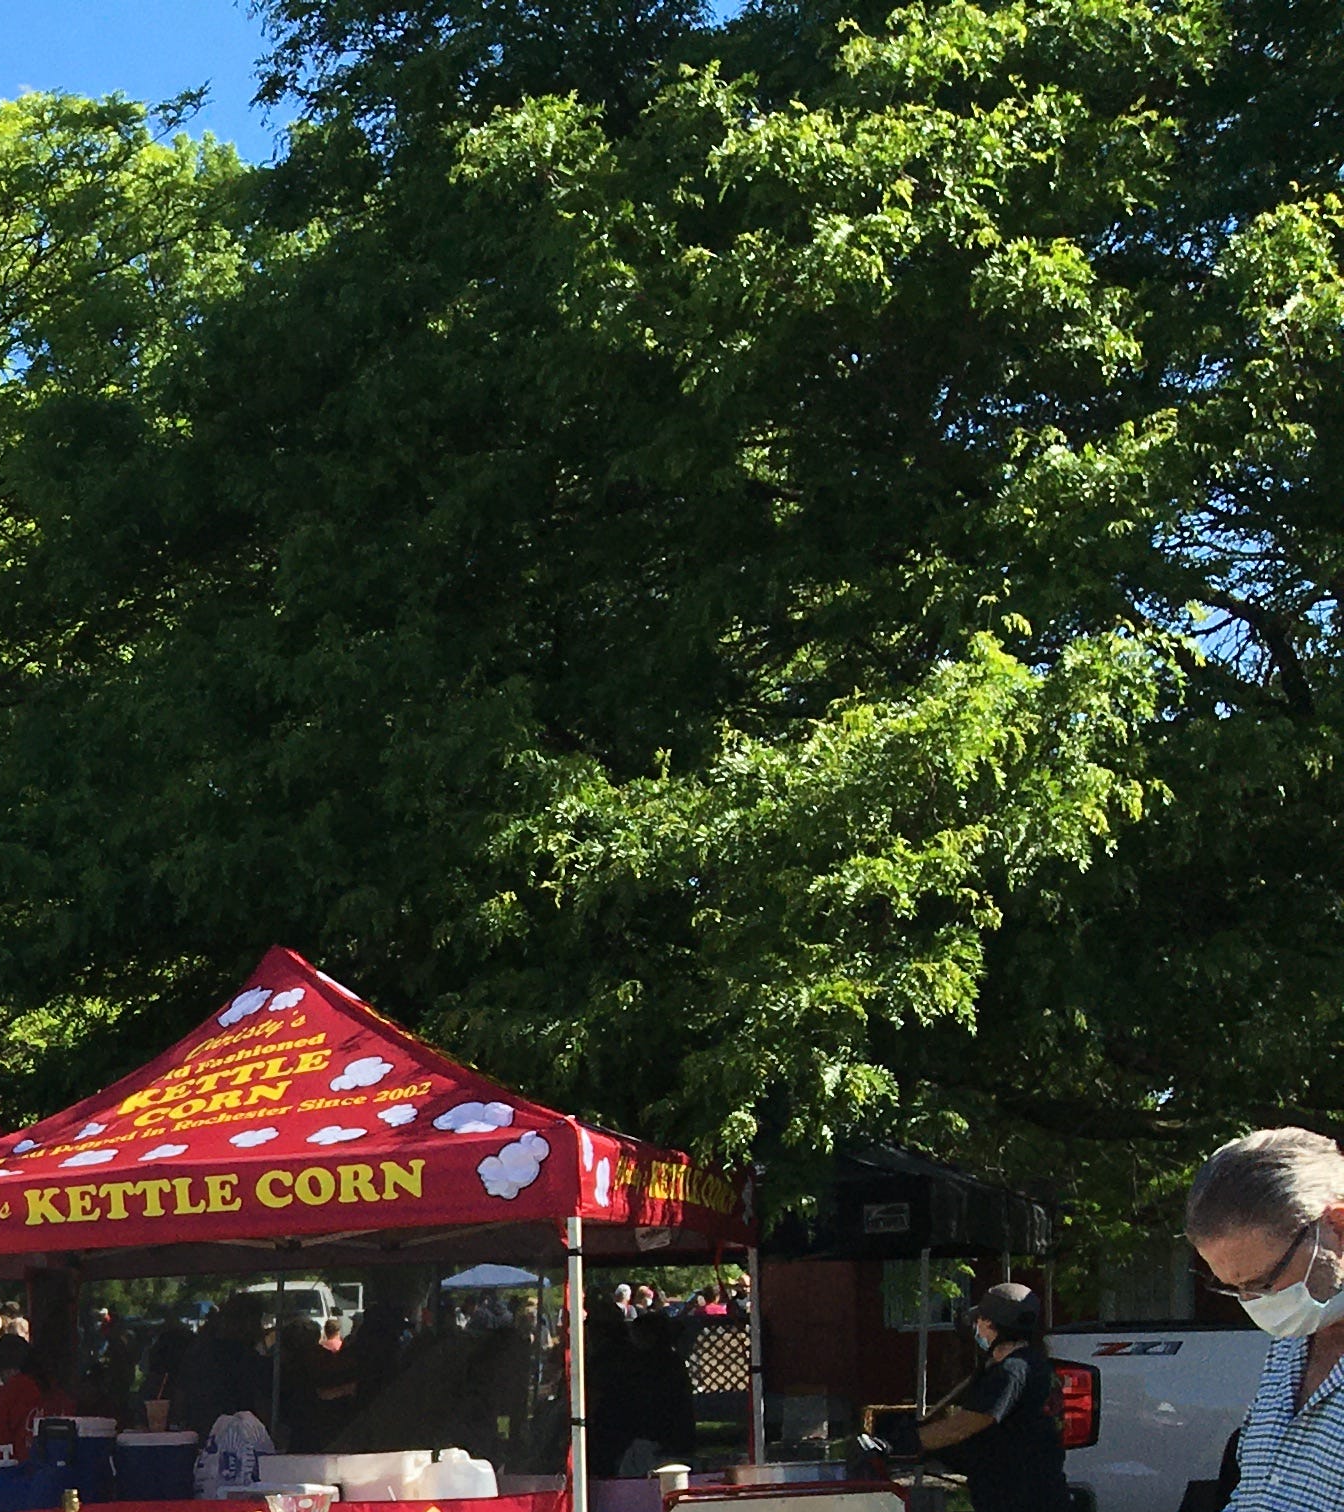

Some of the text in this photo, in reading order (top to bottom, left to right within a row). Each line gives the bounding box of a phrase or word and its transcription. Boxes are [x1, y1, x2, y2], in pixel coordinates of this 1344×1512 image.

[117, 1048, 333, 1116] KETTLE
[195, 1032, 327, 1073] Fashioned
[51, 1131, 138, 1157] Popped
[141, 1127, 166, 1139] in
[170, 1104, 293, 1132] Rochester
[296, 1093, 368, 1113] Since
[372, 1081, 433, 1103] 2002
[133, 1080, 293, 1128] CORN
[24, 1173, 242, 1227] KETTLE
[255, 1159, 427, 1211] CORN
